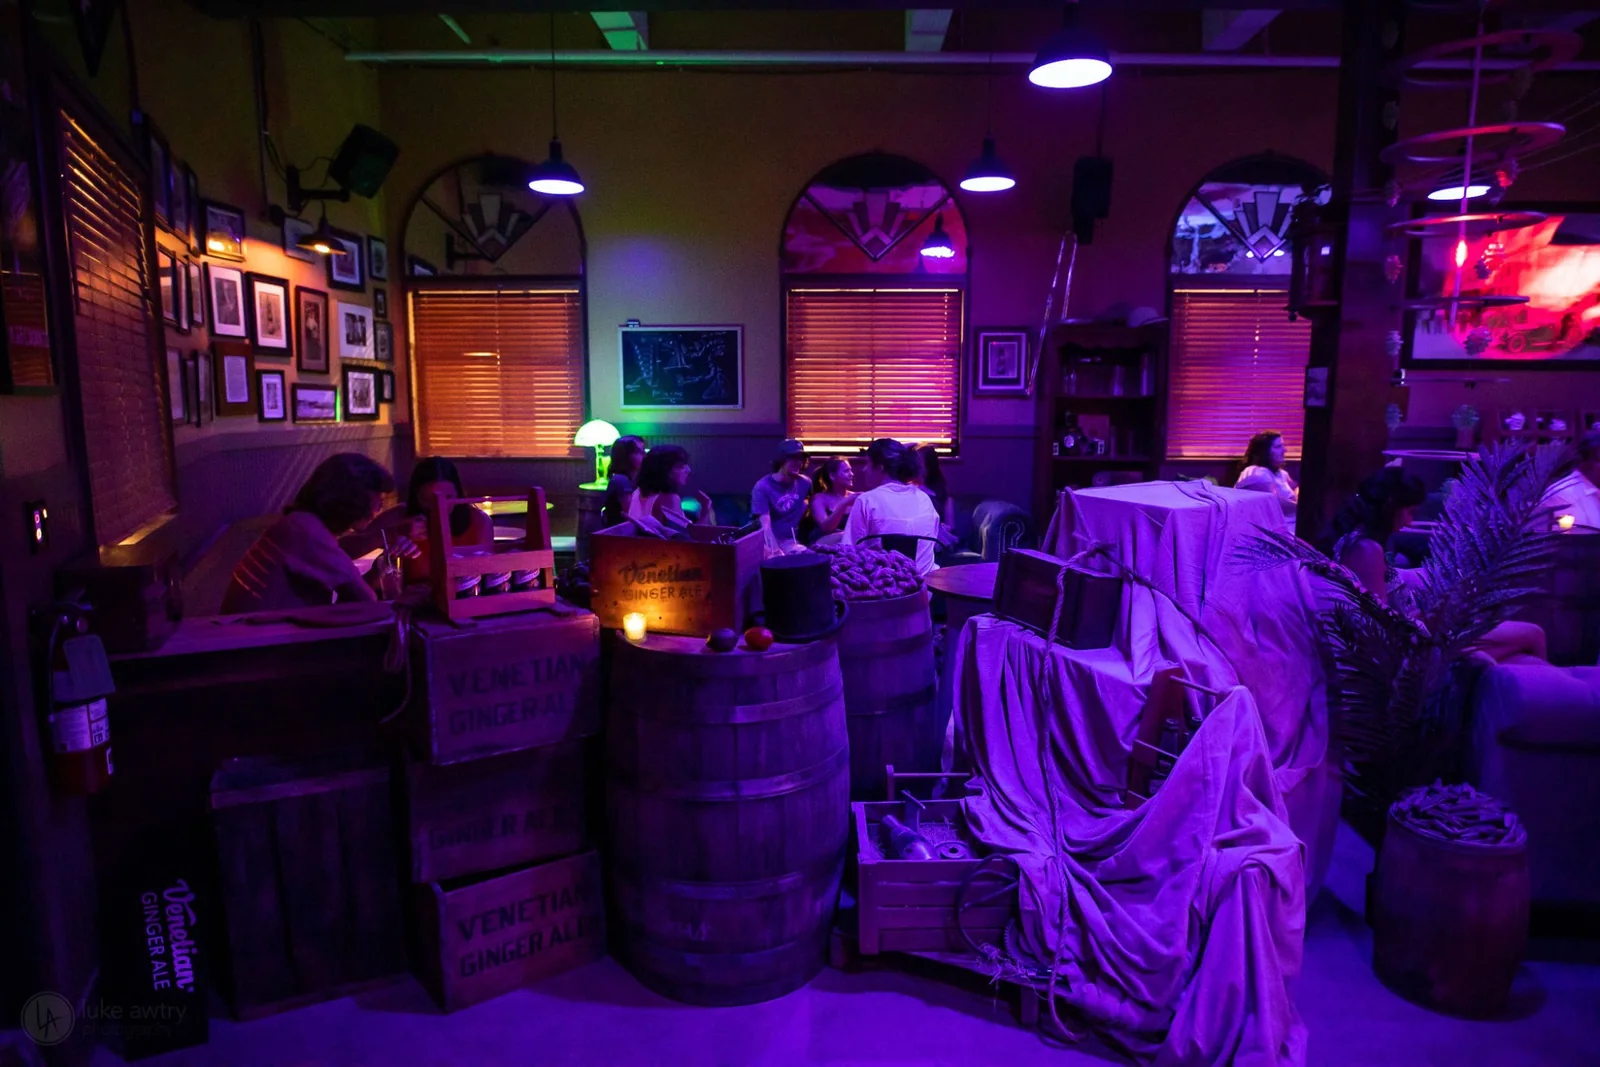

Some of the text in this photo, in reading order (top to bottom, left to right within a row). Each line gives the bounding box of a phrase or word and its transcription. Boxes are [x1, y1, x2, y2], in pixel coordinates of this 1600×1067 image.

[624, 585, 703, 601] GINGER ALE
[447, 652, 585, 698] VENETIAN
[449, 696, 538, 736] GINGER
[162, 877, 197, 993] Venetian
[456, 881, 590, 942] VENETIAN
[141, 891, 171, 992] GINGER ALE
[460, 931, 543, 978] GINGER
